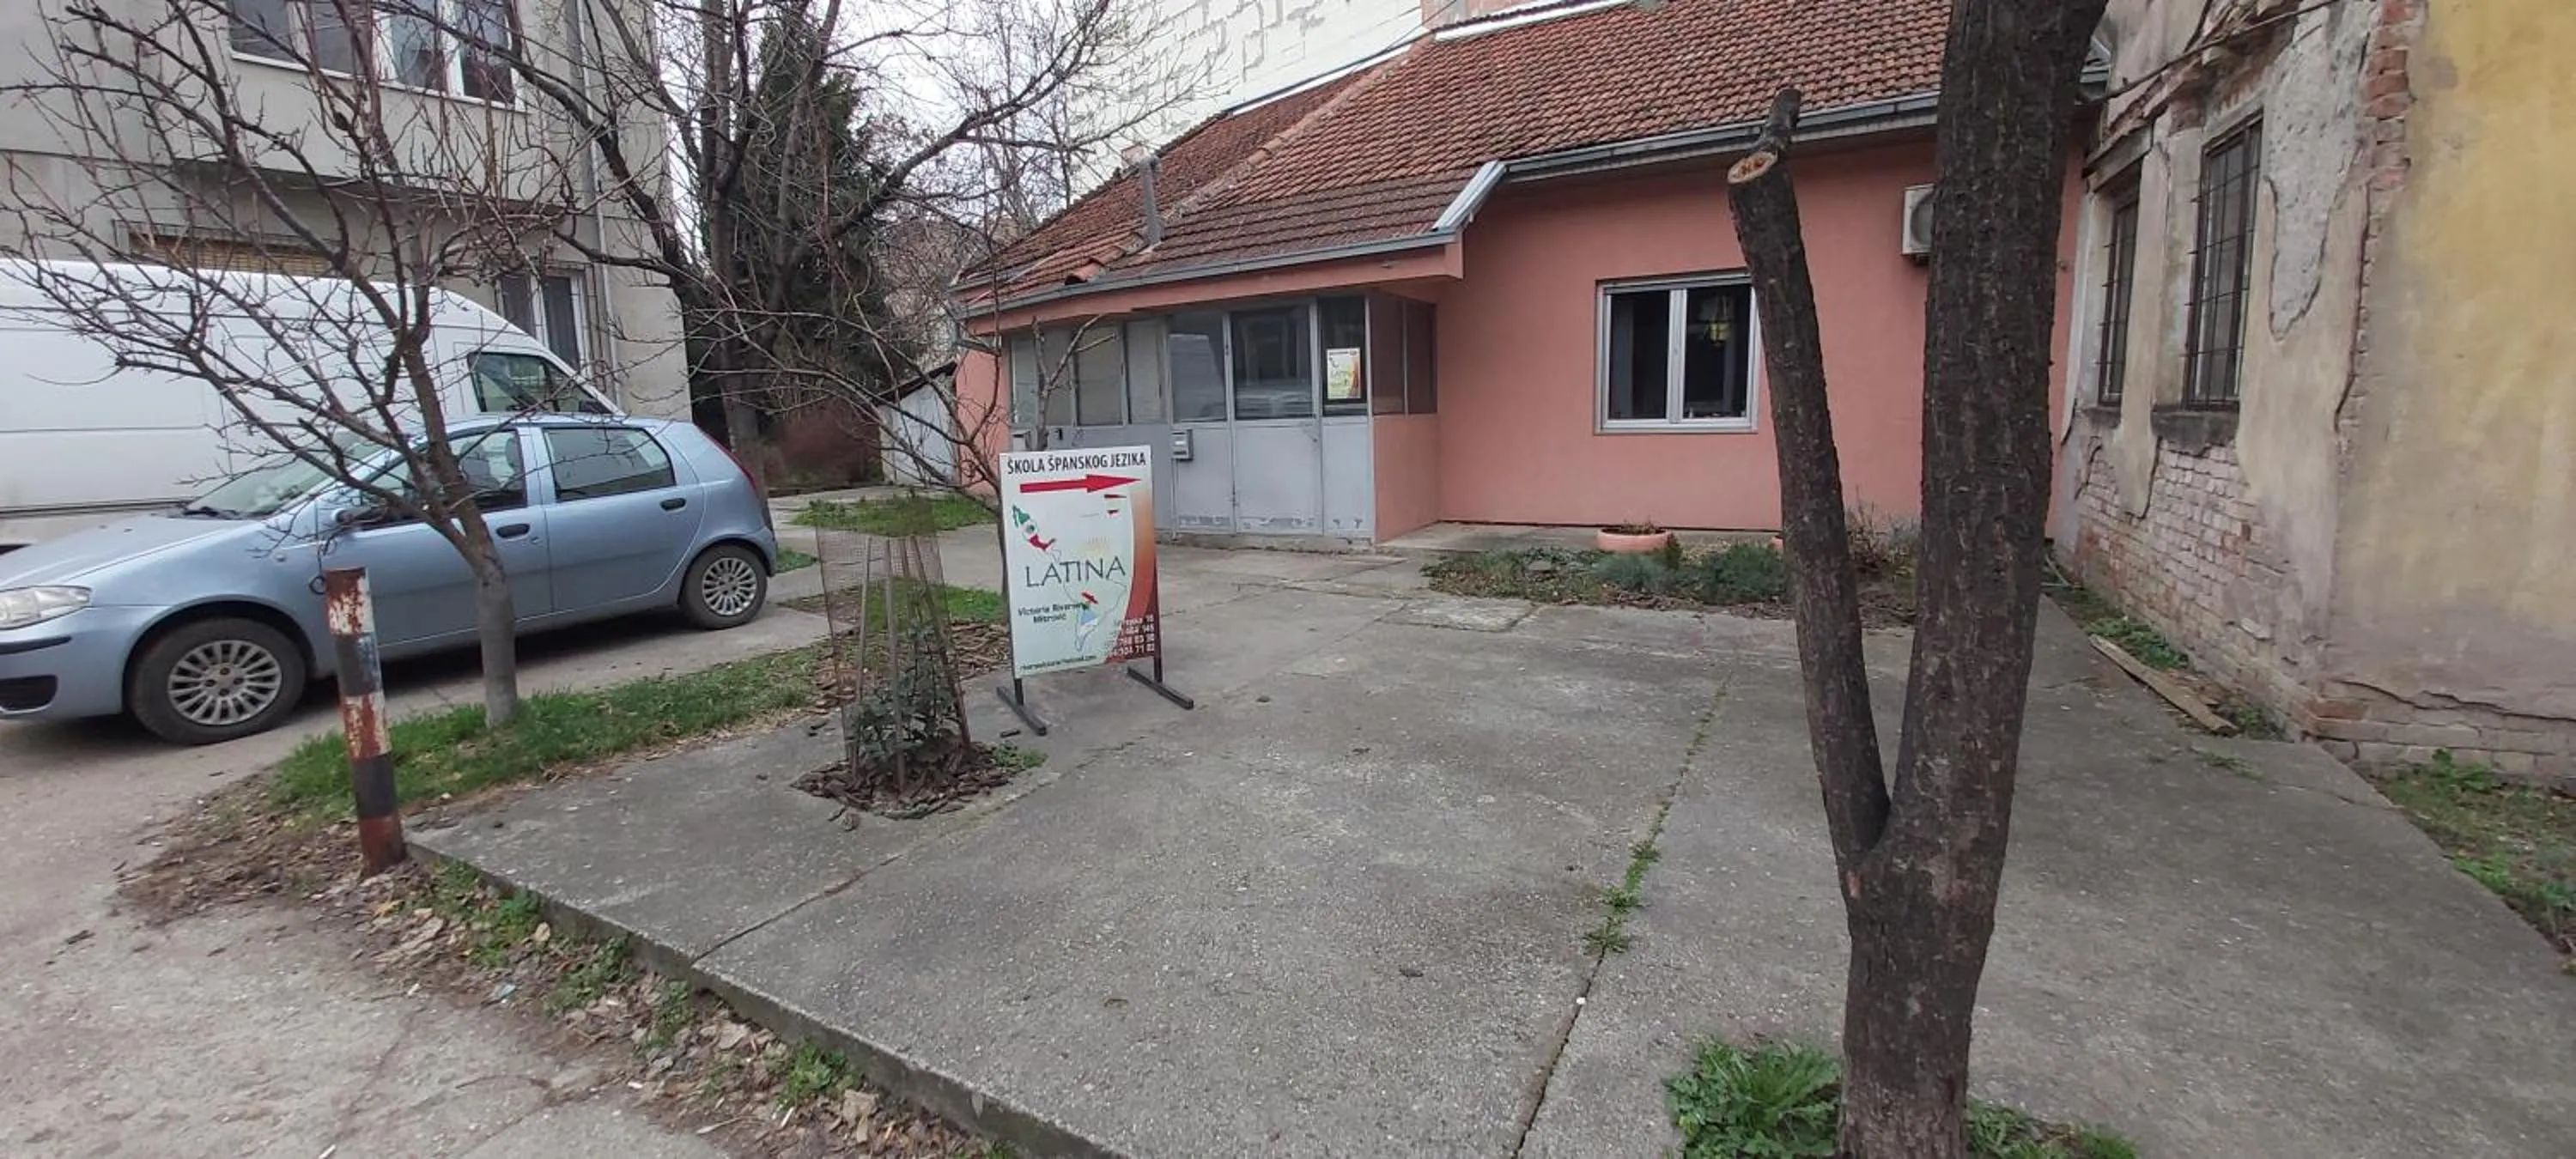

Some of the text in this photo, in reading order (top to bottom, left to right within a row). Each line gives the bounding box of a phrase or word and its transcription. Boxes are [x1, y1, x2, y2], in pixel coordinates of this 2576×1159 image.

[1007, 452, 1146, 474] ŠKOLA ŠPANSKOG JEZIKA
[1025, 555, 1127, 587] LATINA
